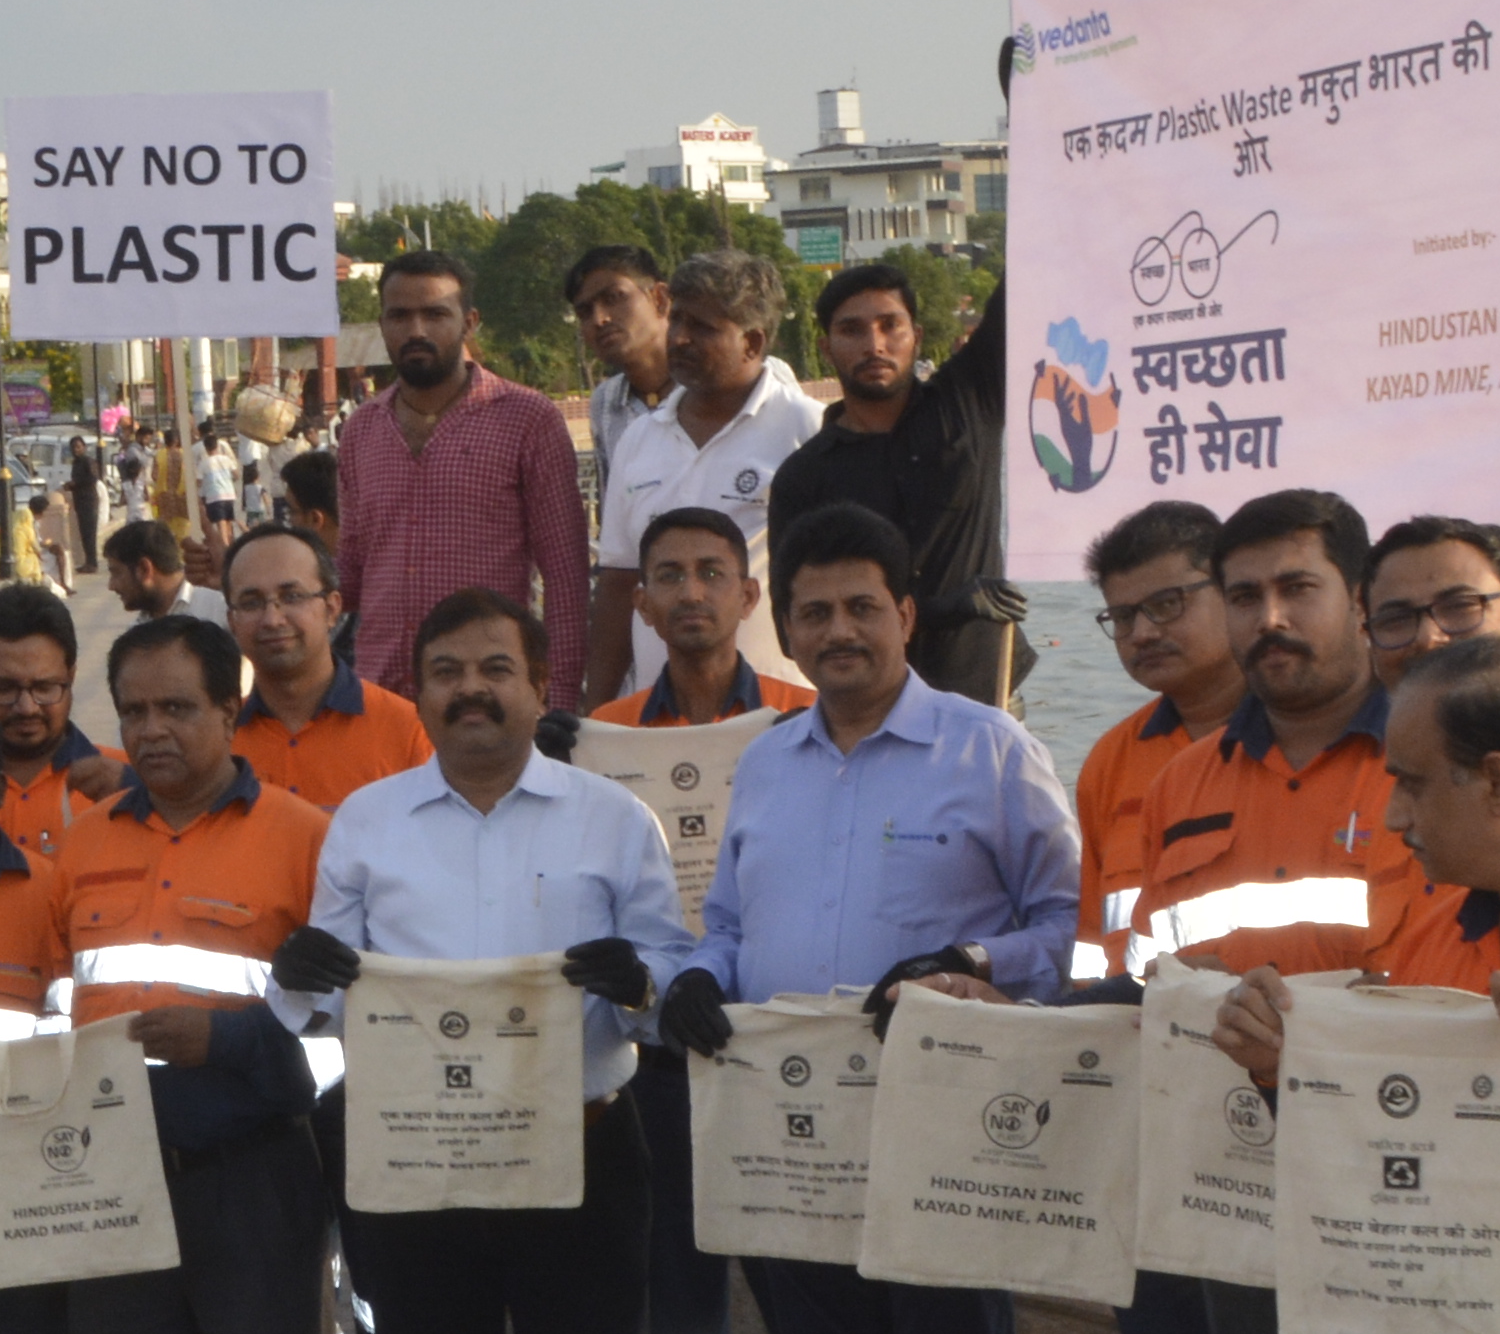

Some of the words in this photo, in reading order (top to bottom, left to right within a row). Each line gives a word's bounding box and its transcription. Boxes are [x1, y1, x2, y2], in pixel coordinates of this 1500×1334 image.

[1039, 10, 1111, 52] vedanta
[1063, 126, 1091, 162] एक
[1156, 99, 1221, 144] Plastic
[1222, 84, 1292, 127] Waste
[1368, 42, 1444, 91] भारत
[1452, 20, 1493, 74] की
[719, 131, 753, 141] ACADEMY
[34, 145, 124, 187] SAY
[144, 145, 221, 186] NO
[238, 143, 307, 185] TO
[1233, 129, 1272, 177] ओर
[23, 223, 318, 285] PLASTIC
[1413, 230, 1468, 255] Initiated
[1379, 308, 1497, 347] HINDUSTAN
[1131, 328, 1287, 395] स्वच्छता
[1366, 372, 1429, 402] KAYAD
[1434, 364, 1493, 395] MINE,
[1144, 404, 1187, 485] ही
[1194, 401, 1283, 472] सेवा
[938, 1041, 983, 1054] vedanta
[1001, 1101, 1029, 1114] SAY
[1237, 1094, 1261, 1110] SAY
[54, 1131, 75, 1143] SAY
[930, 1176, 1036, 1201] HINDUSTAN
[1042, 1188, 1084, 1205] ZINC
[1195, 1172, 1275, 1200] HINDUSTA
[13, 1202, 91, 1219] HINDUSTAN
[94, 1197, 123, 1211] ZINC
[913, 1198, 971, 1216] KAYAD
[977, 1206, 1030, 1224] MINE,
[1036, 1212, 1097, 1231] AJMER
[1182, 1195, 1231, 1217] KAYAD
[4, 1225, 48, 1241] KAYAD
[93, 1215, 140, 1230] AJMER
[1445, 1223, 1467, 1239] की
